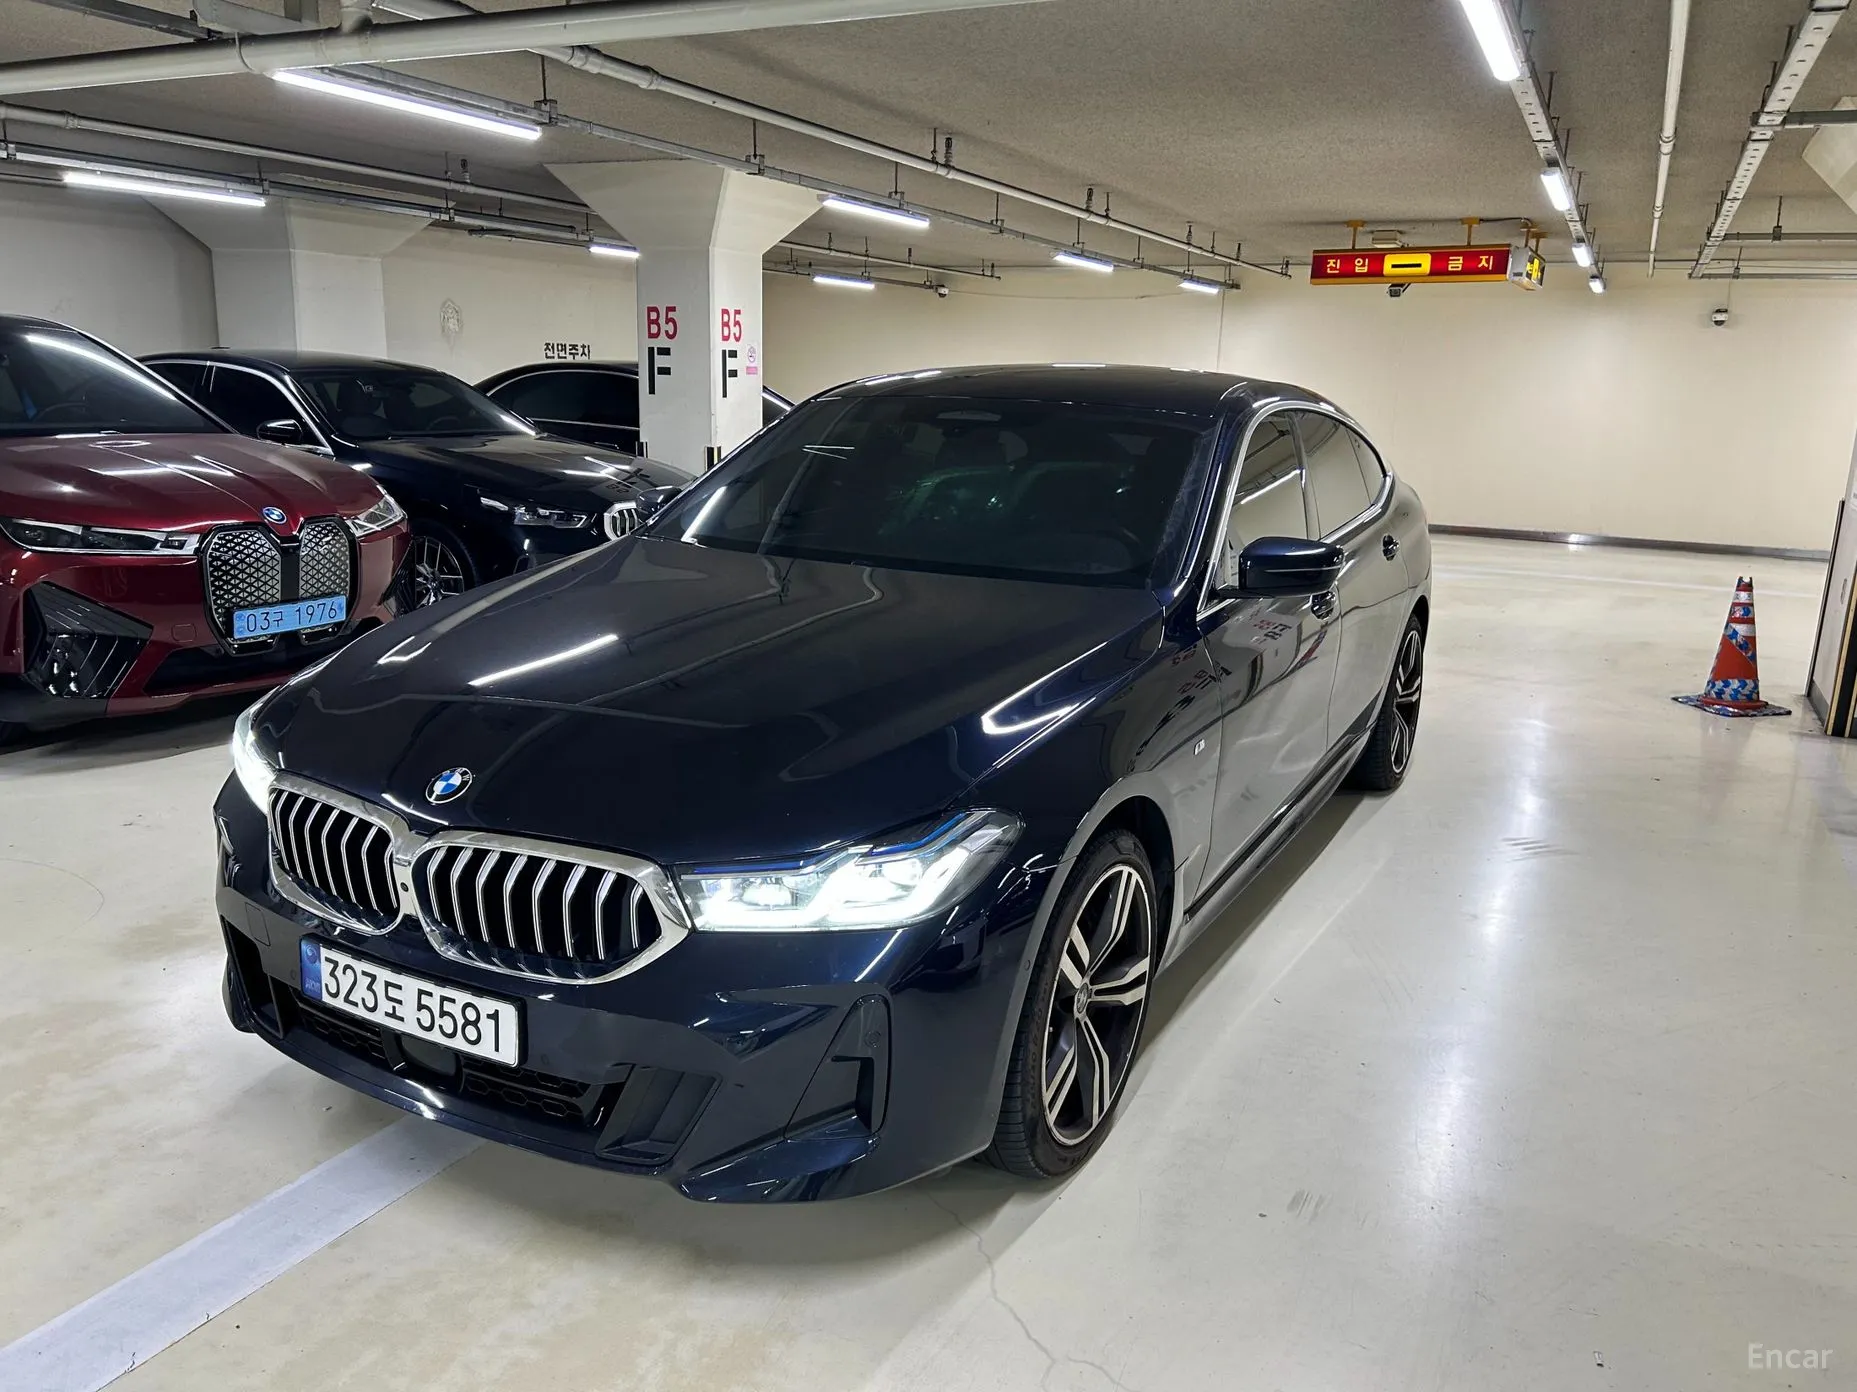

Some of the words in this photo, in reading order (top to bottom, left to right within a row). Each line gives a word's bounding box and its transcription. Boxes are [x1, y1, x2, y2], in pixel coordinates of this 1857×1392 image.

[646, 305, 678, 340] B5
[721, 308, 742, 343] B5
[543, 342, 591, 360] 전면주차
[647, 346, 672, 395] F
[721, 349, 738, 398] F
[246, 611, 284, 633] 03구
[295, 600, 337, 625] 1976
[324, 956, 405, 1023] 323도
[416, 988, 500, 1053] 5581
